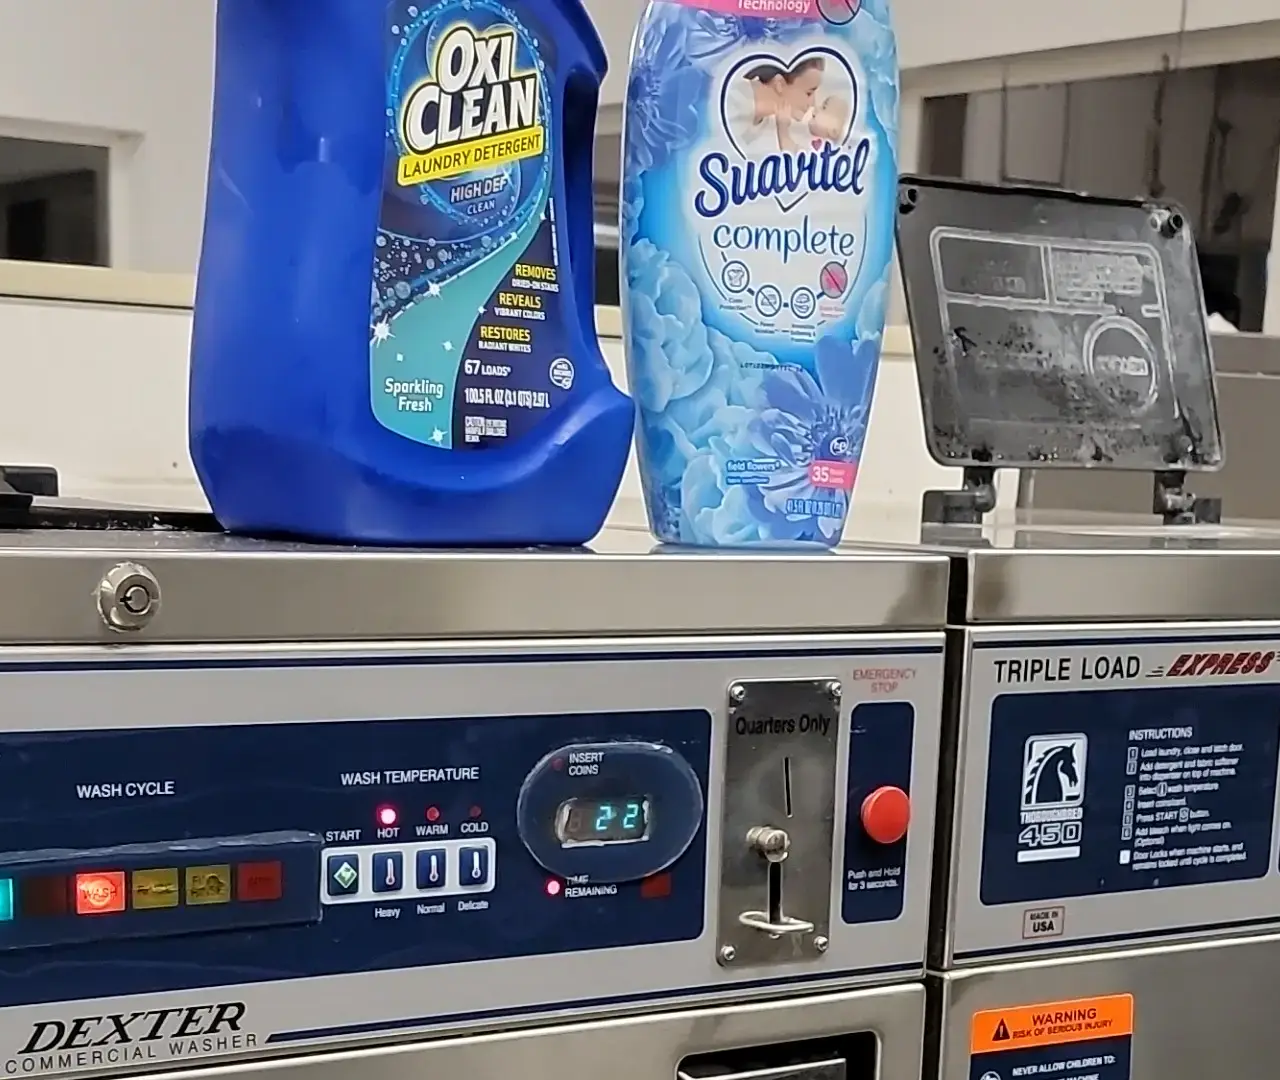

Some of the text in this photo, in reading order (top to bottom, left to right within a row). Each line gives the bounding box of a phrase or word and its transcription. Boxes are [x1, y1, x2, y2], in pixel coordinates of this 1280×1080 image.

[738, 0, 811, 13] Technology
[437, 27, 514, 94] OXI
[405, 76, 537, 154] CLEAN
[403, 134, 541, 179] LAUNDRY DETERGENT
[694, 138, 871, 218] Suavitel
[451, 178, 507, 203] HIGH DEF
[467, 200, 495, 215] CLEAN
[713, 215, 855, 264] complete
[515, 264, 556, 281] REMOVES
[499, 292, 541, 308] REVEALS
[480, 326, 531, 342] RESTORES
[464, 359, 480, 375] 67
[385, 377, 444, 398] Sparkling
[398, 397, 433, 412] Fresh
[811, 466, 830, 482] 35
[852, 667, 917, 680] EMERGENCY
[993, 651, 1276, 683] TRIPLE LOAD EXPRESS
[871, 682, 899, 694] STOP
[735, 713, 831, 736] Quarters Only
[569, 752, 604, 764] INSERT
[341, 767, 480, 786] WASH TEMPERATURE
[569, 765, 599, 776] COINS
[76, 781, 175, 799] WASH CYCLE
[326, 829, 362, 842] START
[377, 827, 400, 839] HOT
[415, 824, 449, 836] WARM
[460, 822, 489, 834] COLD
[1018, 821, 1082, 847] 450
[565, 884, 617, 898] REMAINING
[374, 907, 401, 920] Heavy
[416, 902, 446, 915] Normal
[458, 900, 489, 912] Delicate
[1032, 920, 1055, 933] USA
[1031, 1008, 1097, 1027] WARNING
[17, 1001, 247, 1055] DEXTER
[5, 1033, 257, 1075] COMMERCIAL WASHER
[1012, 1064, 1038, 1077] NEVER
[1038, 1061, 1066, 1073] ALLOW
